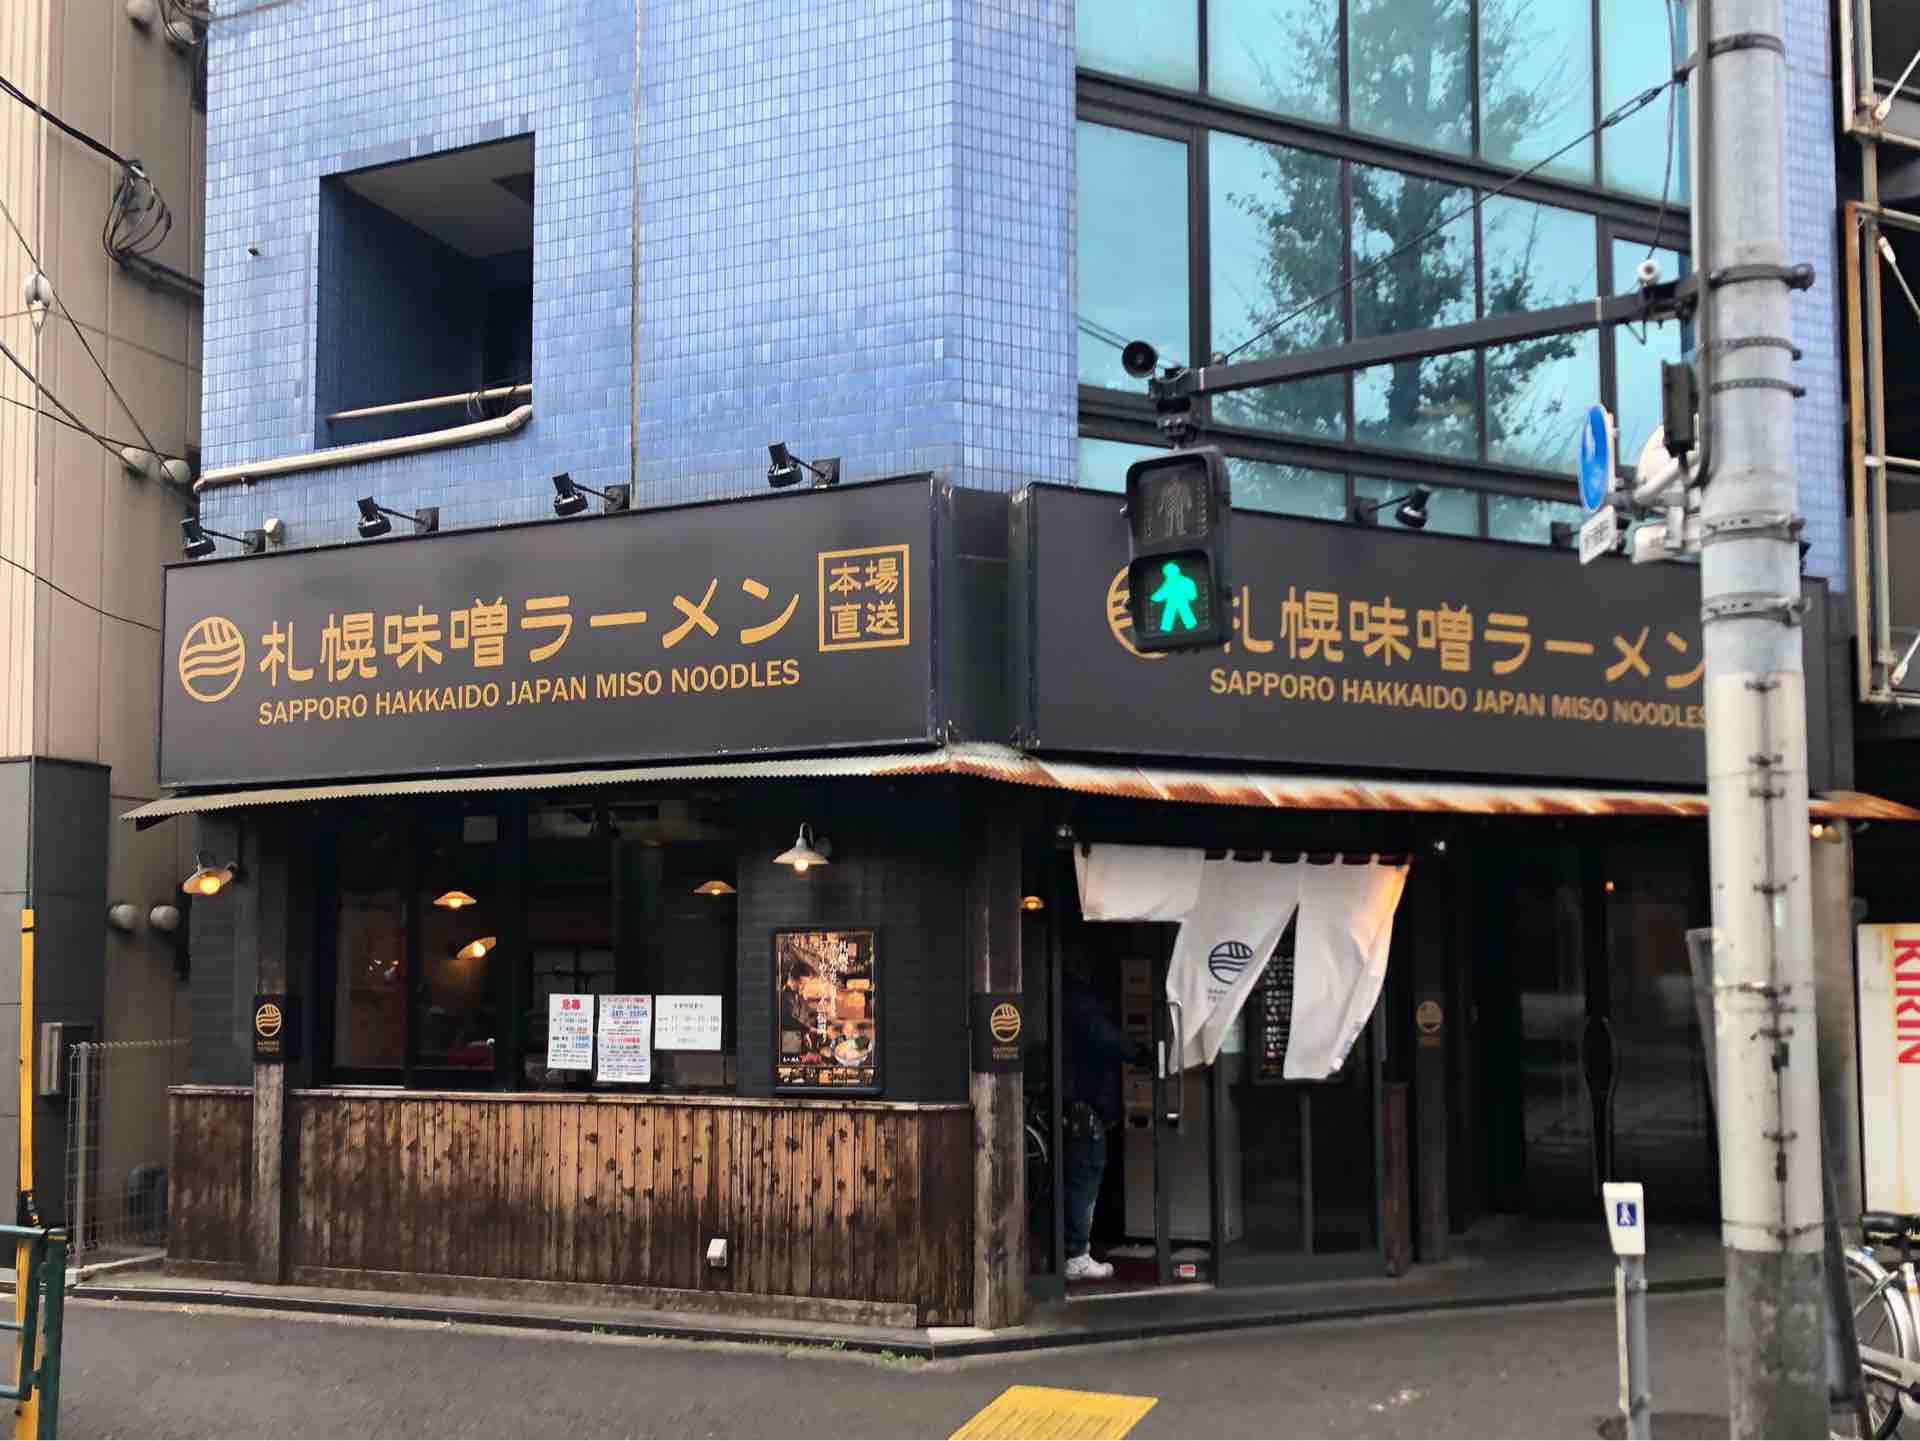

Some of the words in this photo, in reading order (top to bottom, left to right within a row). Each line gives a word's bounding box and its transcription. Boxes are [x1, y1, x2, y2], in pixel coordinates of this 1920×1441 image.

[828, 557, 899, 597] 本場
[259, 578, 800, 688] 札幌味噌ラーメン
[829, 599, 899, 640] 直送
[258, 693, 368, 727] SAPPORO
[376, 682, 500, 716] HAKKAIDO
[506, 675, 587, 706] JAPAN
[595, 669, 662, 699] MISO
[671, 658, 800, 695] NOODLES
[1209, 667, 1335, 703] SAPPORO
[1342, 678, 1467, 712] HAKKAIDO
[1472, 687, 1546, 718] JAPAN
[1551, 694, 1609, 722] MISO
[1894, 939, 1920, 1064] KIRIN
